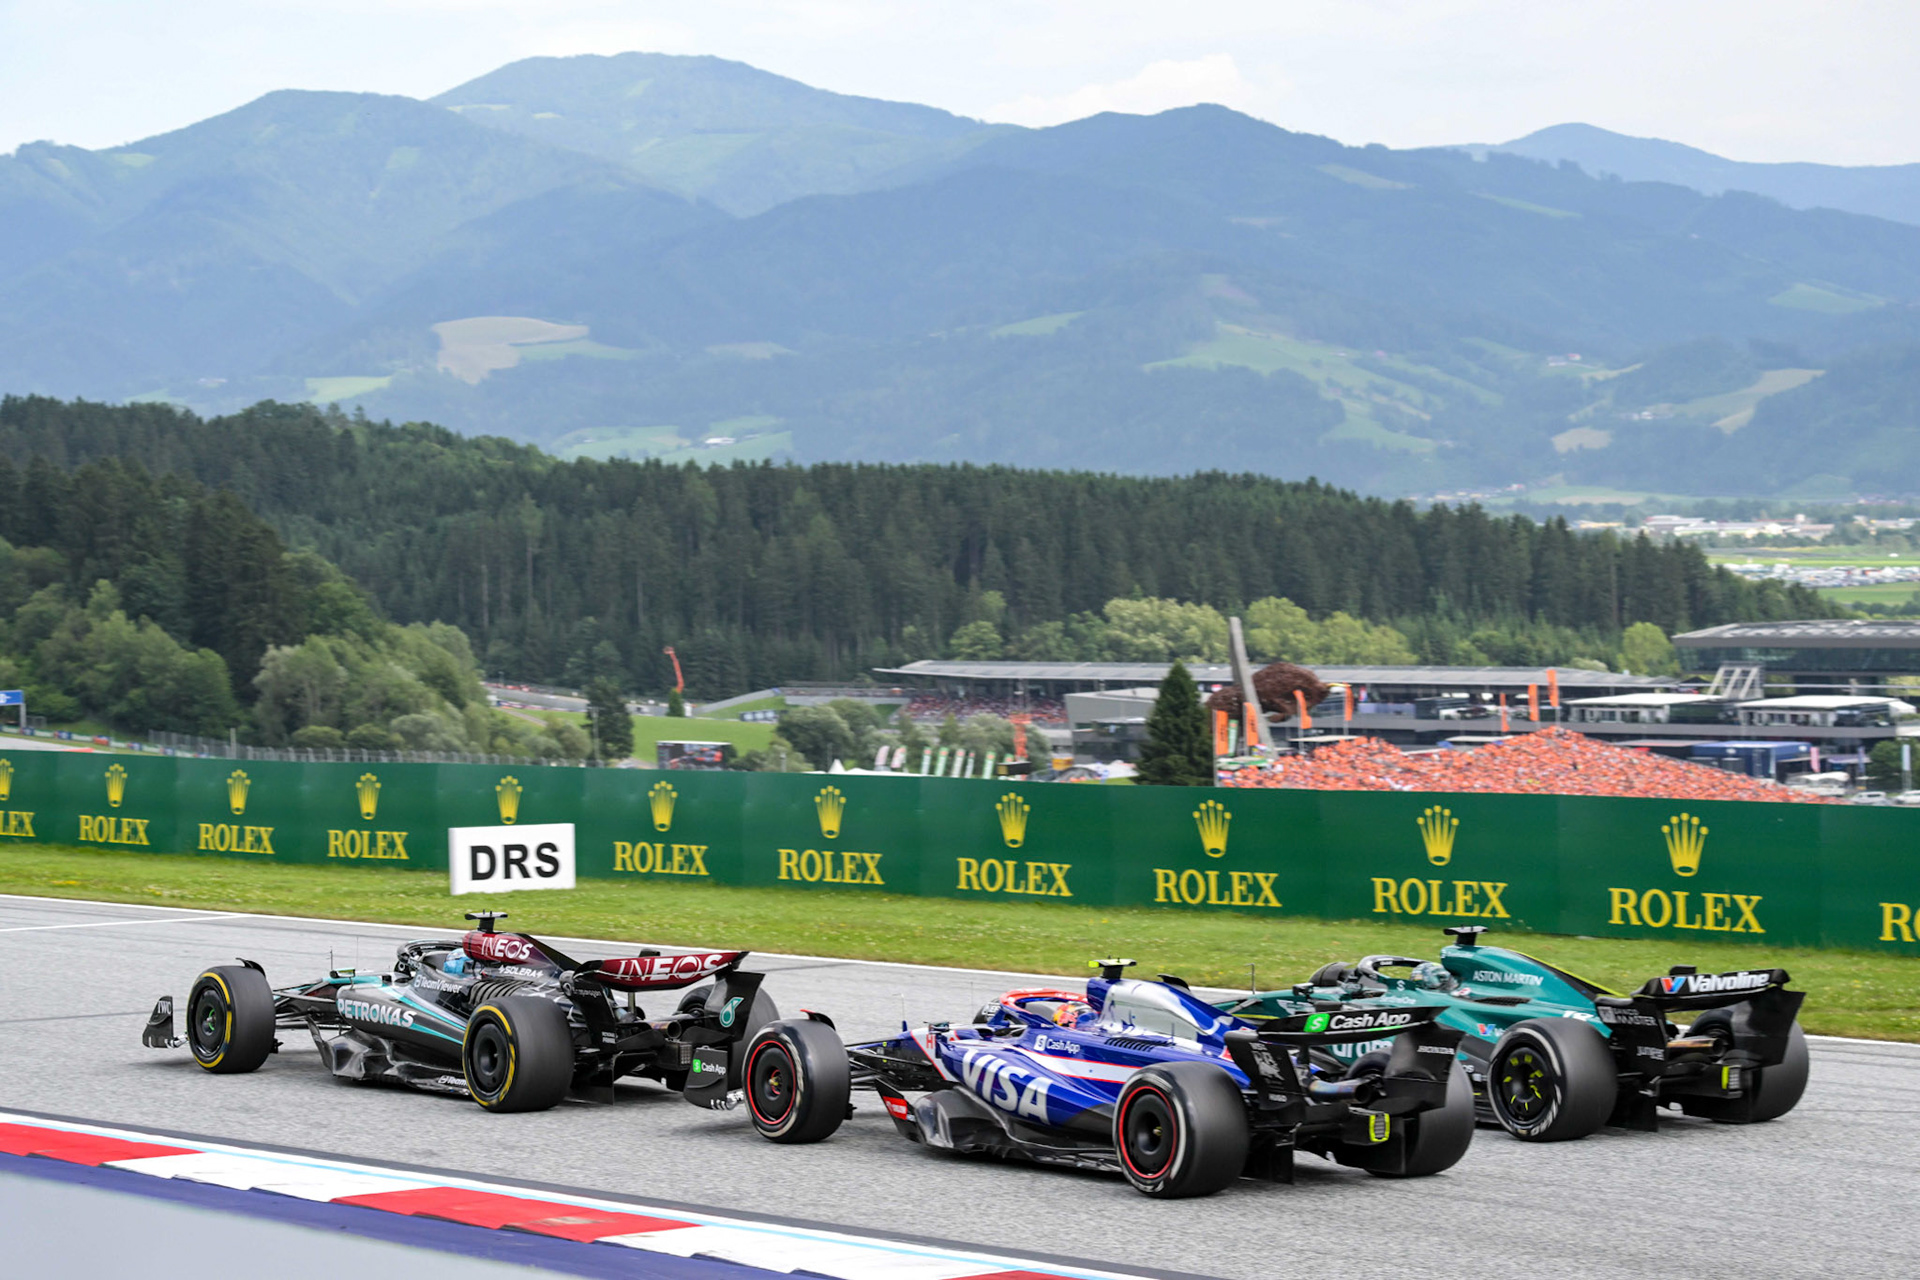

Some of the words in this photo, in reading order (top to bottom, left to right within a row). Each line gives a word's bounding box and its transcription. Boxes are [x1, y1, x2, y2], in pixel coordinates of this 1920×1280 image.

[79, 815, 150, 846] ROLEX
[198, 823, 275, 855] ROLEX
[327, 829, 409, 860] ROLEX
[471, 842, 559, 881] DRS
[614, 841, 709, 876] ROLEX
[778, 849, 885, 885] ROLEX
[957, 857, 1073, 897] ROLEX
[1154, 868, 1281, 907] ROLEX
[1372, 877, 1511, 918] ROLEX
[1609, 887, 1765, 933] ROLEX
[481, 936, 535, 960] INEOS
[503, 965, 537, 978] SOLERA
[616, 953, 724, 981] INEOS
[1472, 970, 1502, 983] ASTON
[1503, 972, 1544, 986] MARTIN
[1688, 971, 1770, 993] Valvoline
[421, 976, 462, 993] TeamViewer
[337, 998, 418, 1028] PETRONAS
[1329, 1012, 1374, 1030] Cash
[1374, 1011, 1412, 1028] App
[1046, 1038, 1064, 1052] Cash
[1065, 1040, 1081, 1055] App
[701, 1062, 715, 1073] Cash
[715, 1065, 727, 1076] App
[963, 1047, 1053, 1125] VISA
